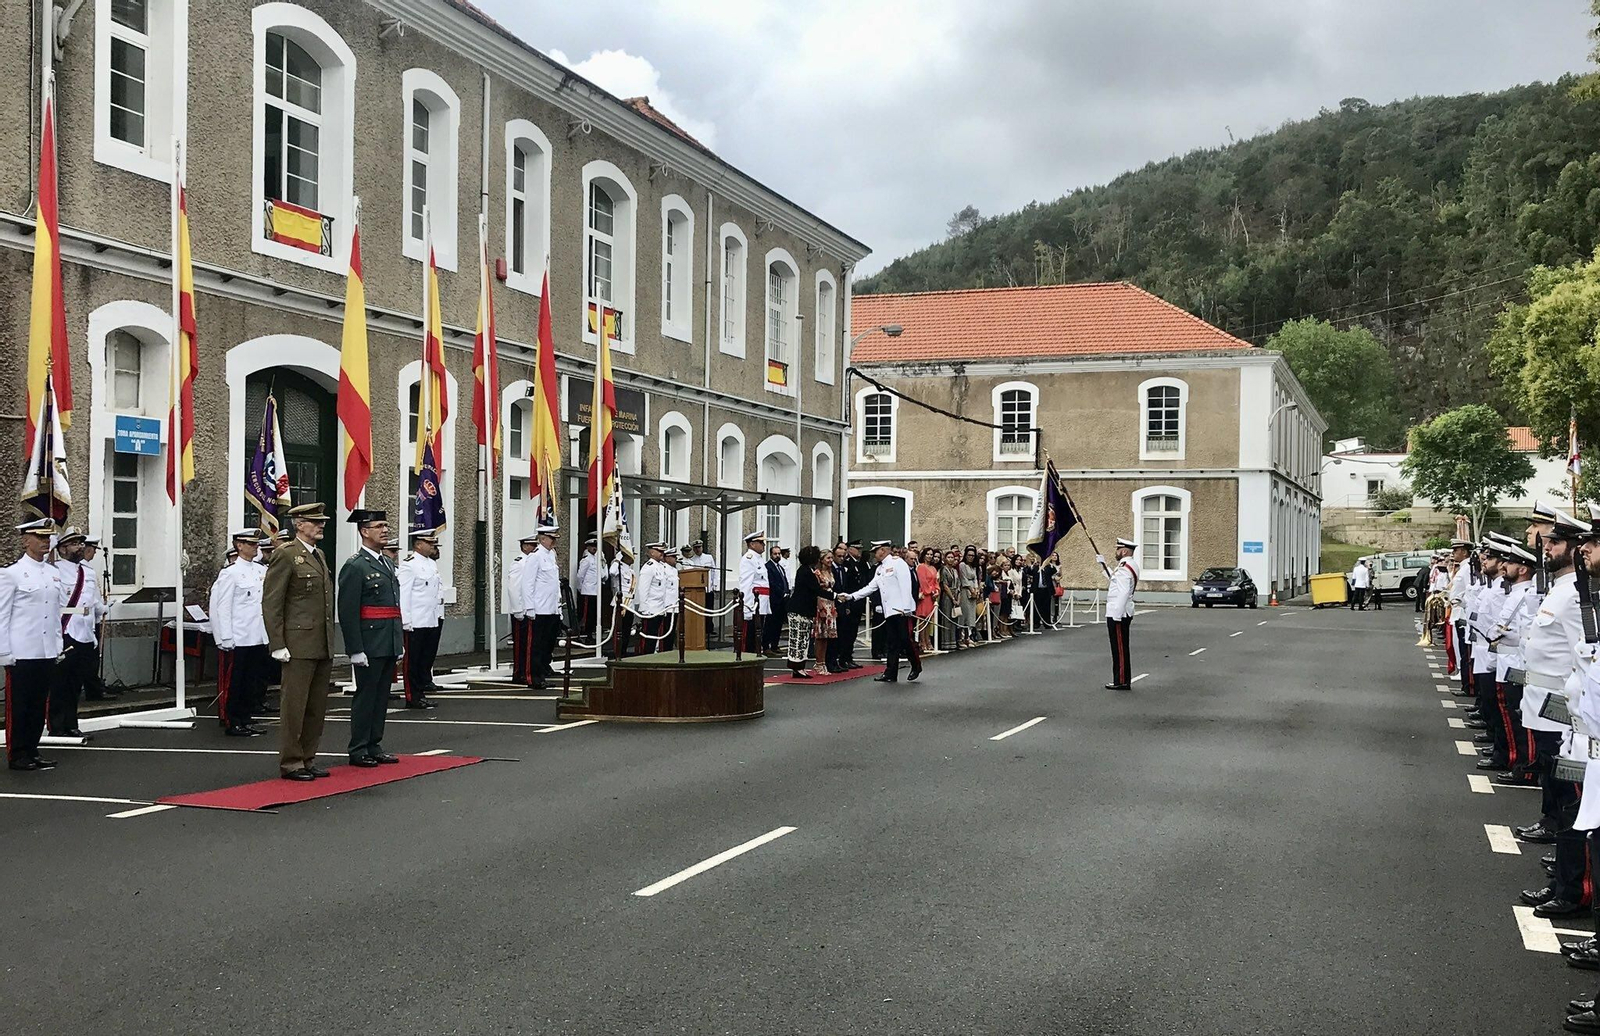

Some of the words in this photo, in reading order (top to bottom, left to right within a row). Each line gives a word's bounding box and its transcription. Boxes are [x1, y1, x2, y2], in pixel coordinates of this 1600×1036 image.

[577, 414, 592, 424] FUER
[612, 420, 639, 431] ROTECCIÓN
[618, 410, 638, 421] MARINA
